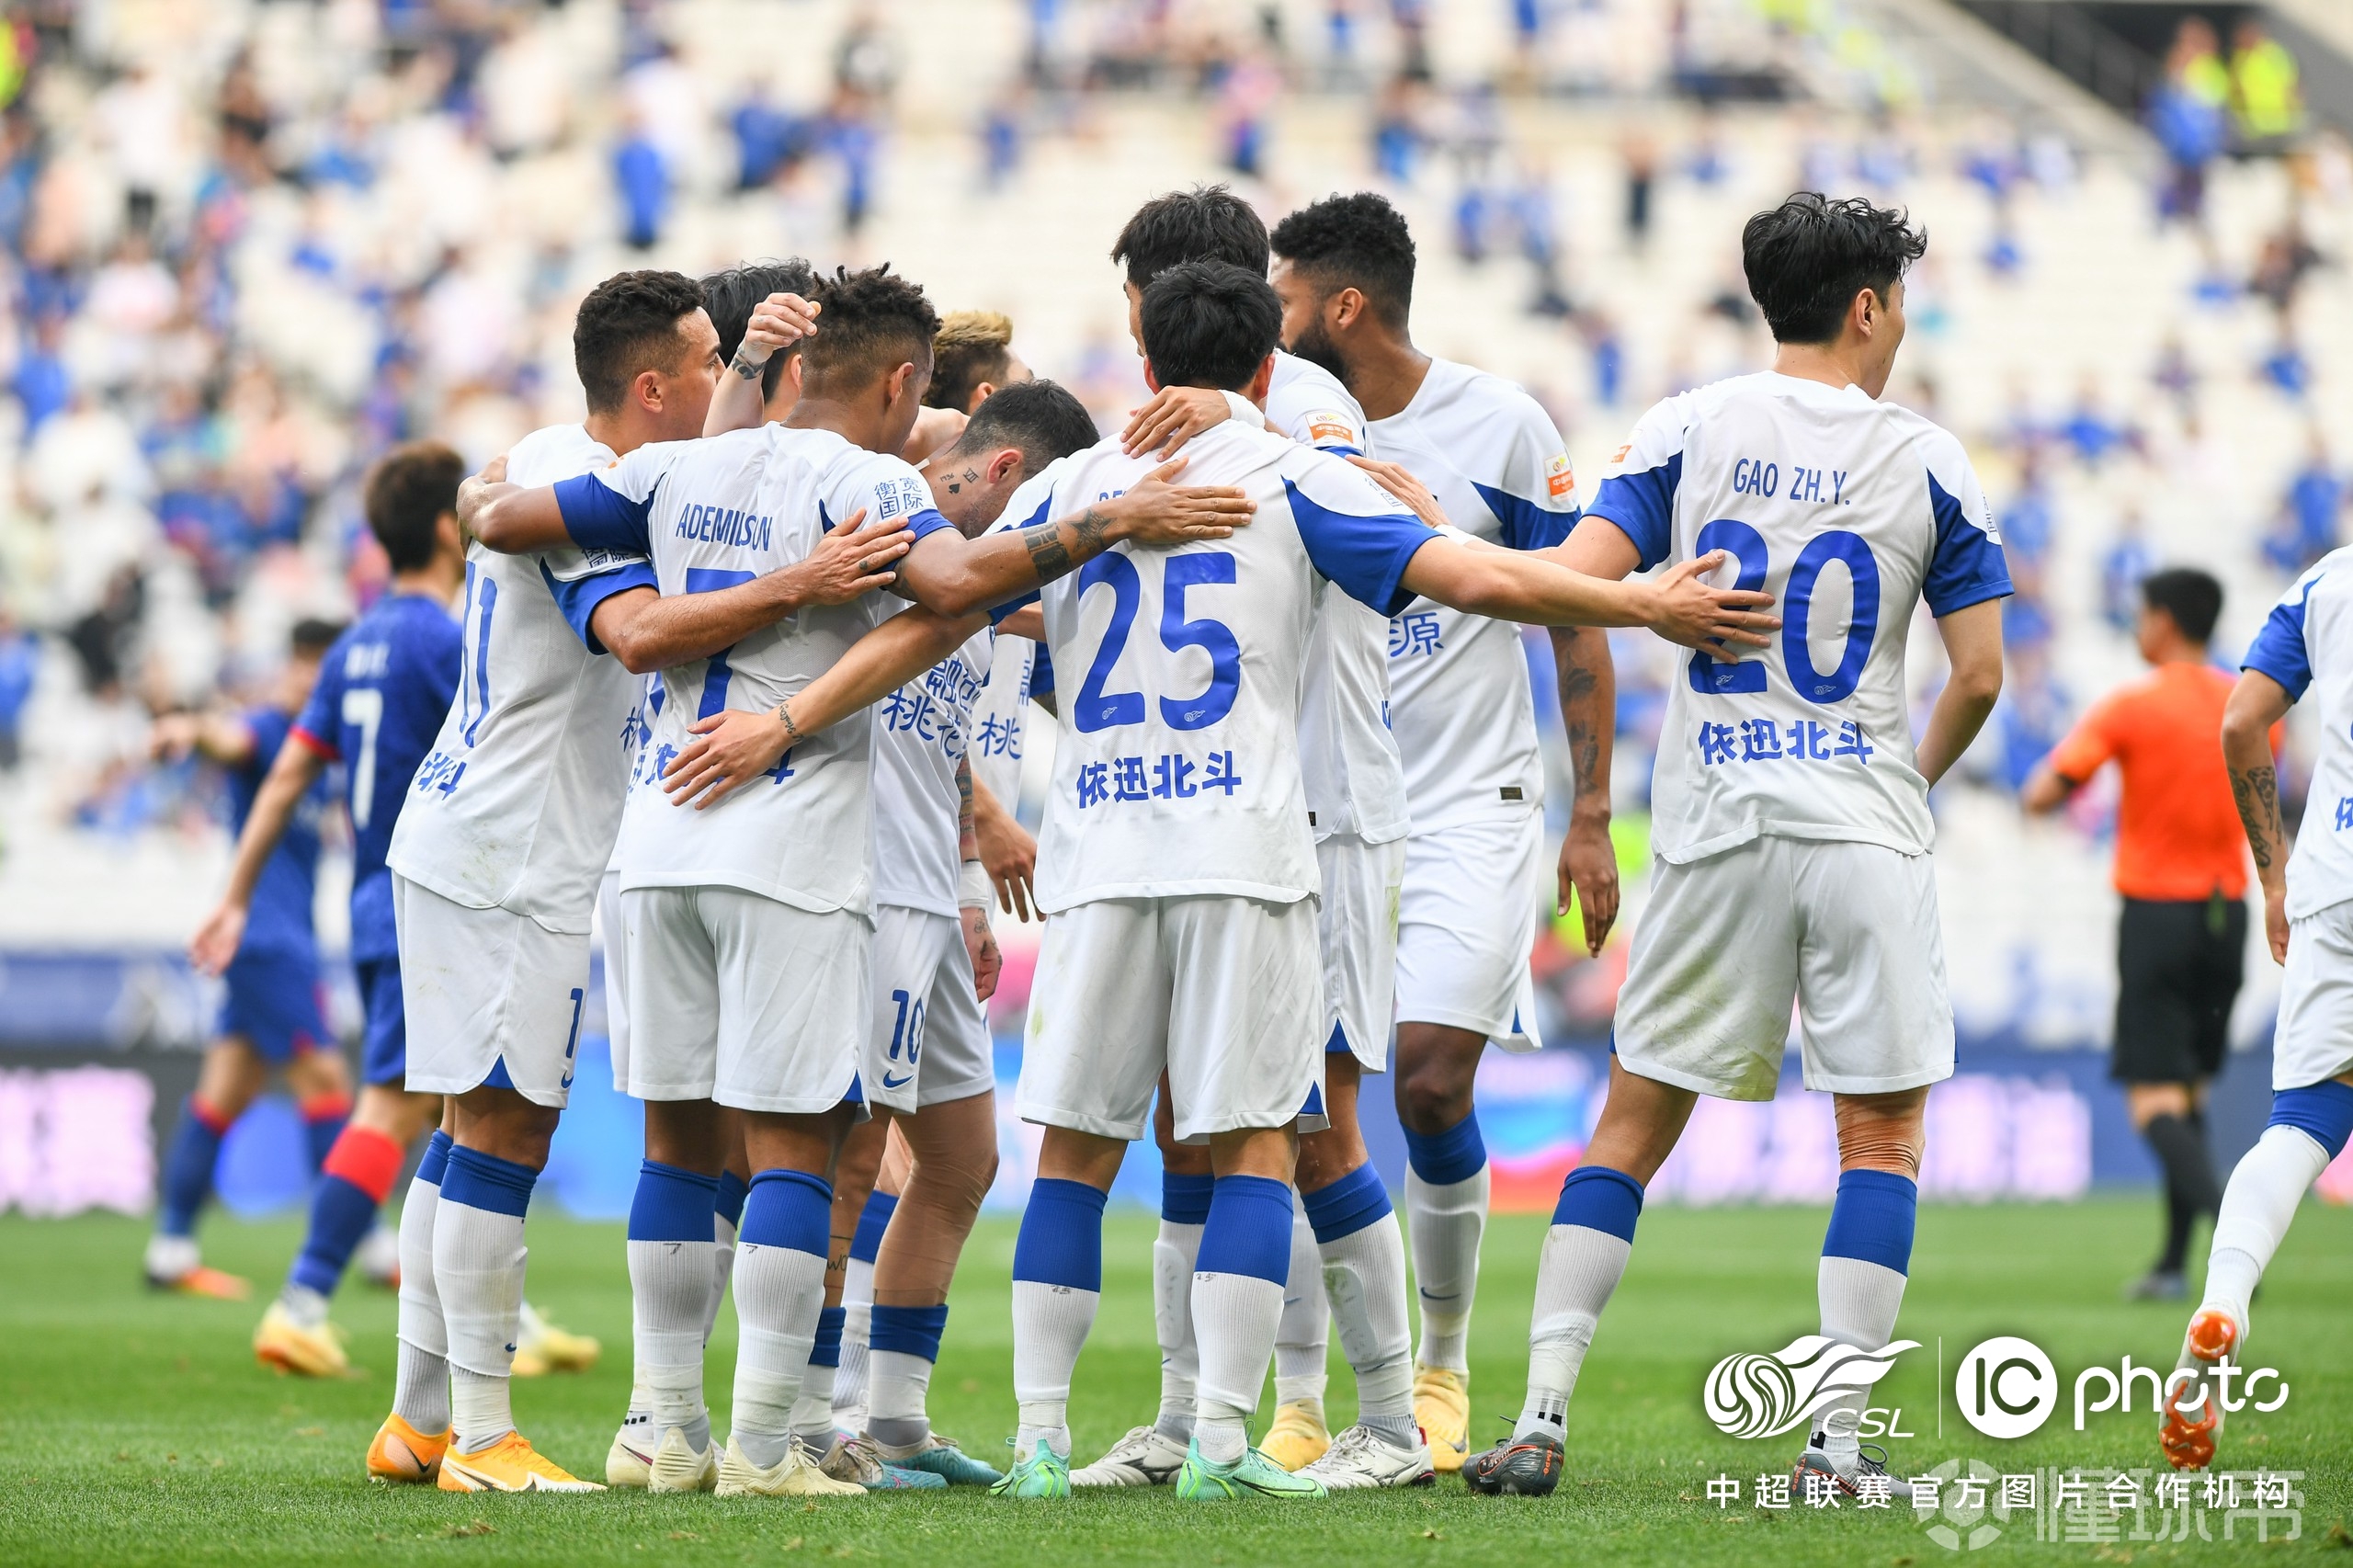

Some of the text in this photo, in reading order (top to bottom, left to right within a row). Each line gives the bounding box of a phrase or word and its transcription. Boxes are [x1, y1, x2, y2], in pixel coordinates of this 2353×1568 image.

[874, 477, 922, 501] 衡宽
[880, 493, 924, 519] 国际
[1733, 458, 1850, 506] GAO ZH.Y.
[1074, 551, 1241, 733] 25
[1688, 519, 1881, 704] 20
[460, 561, 497, 747] 11
[342, 688, 383, 832] 7
[881, 686, 972, 760] 桃花
[1698, 719, 1874, 766] 依迅北斗
[1077, 750, 1242, 809] 依迅北斗
[889, 989, 925, 1064] 10
